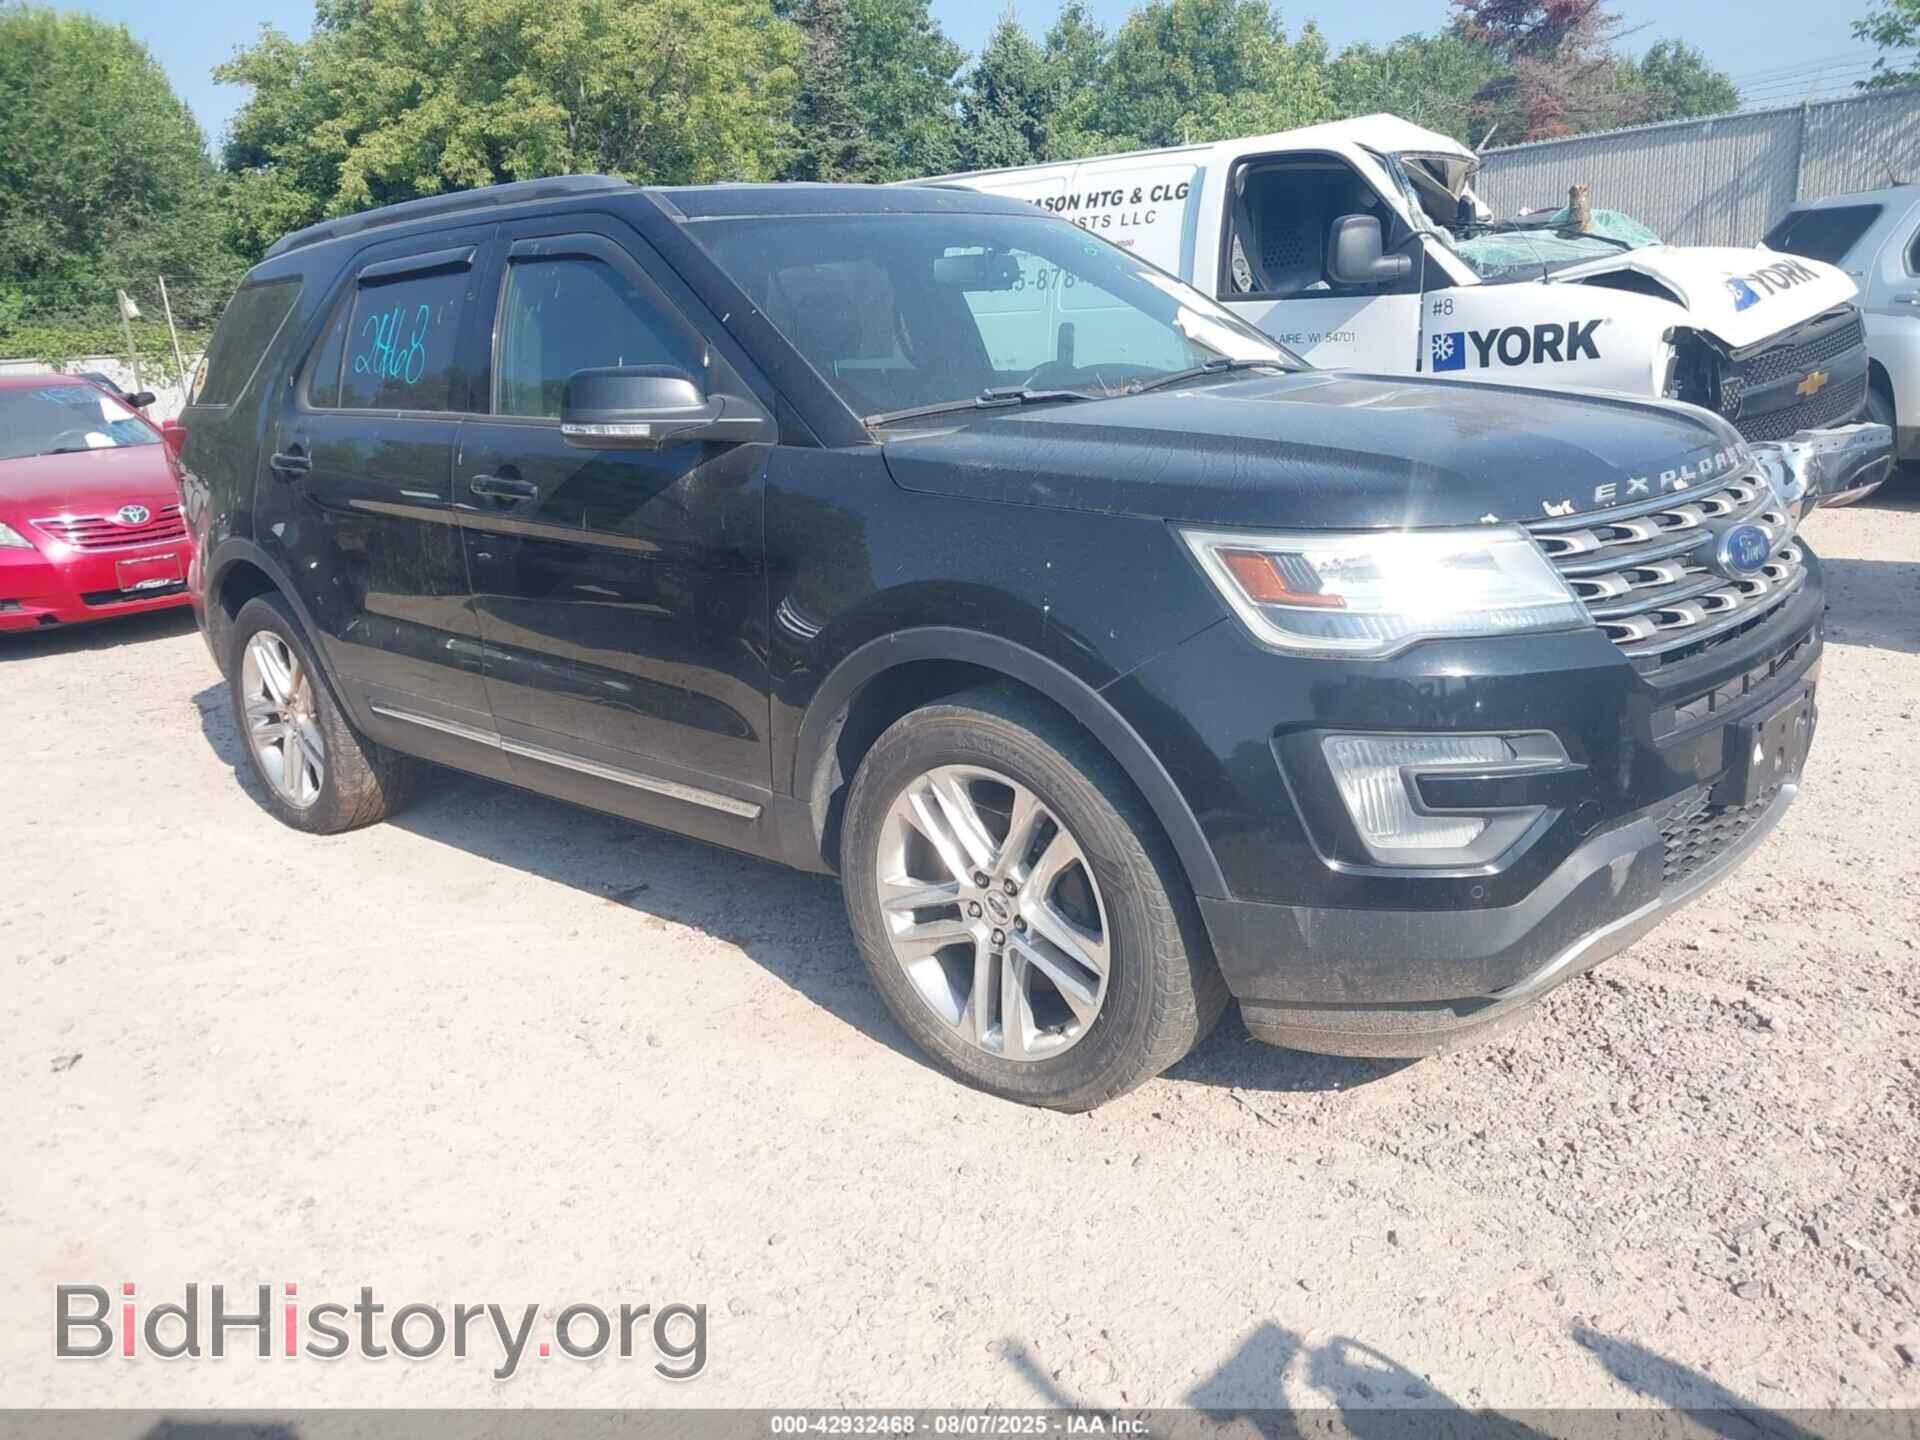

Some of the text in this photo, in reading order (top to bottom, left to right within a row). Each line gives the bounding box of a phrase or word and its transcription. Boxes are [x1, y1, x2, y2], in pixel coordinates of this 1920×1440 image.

[1025, 182, 1190, 212] ASON HTG & CLG
[1120, 210, 1157, 227] LLC
[1749, 258, 1821, 296] YORK
[1432, 298, 1454, 316] #8
[1308, 332, 1322, 343] WI
[1325, 331, 1356, 344] 54701
[1468, 319, 1603, 368] YORK
